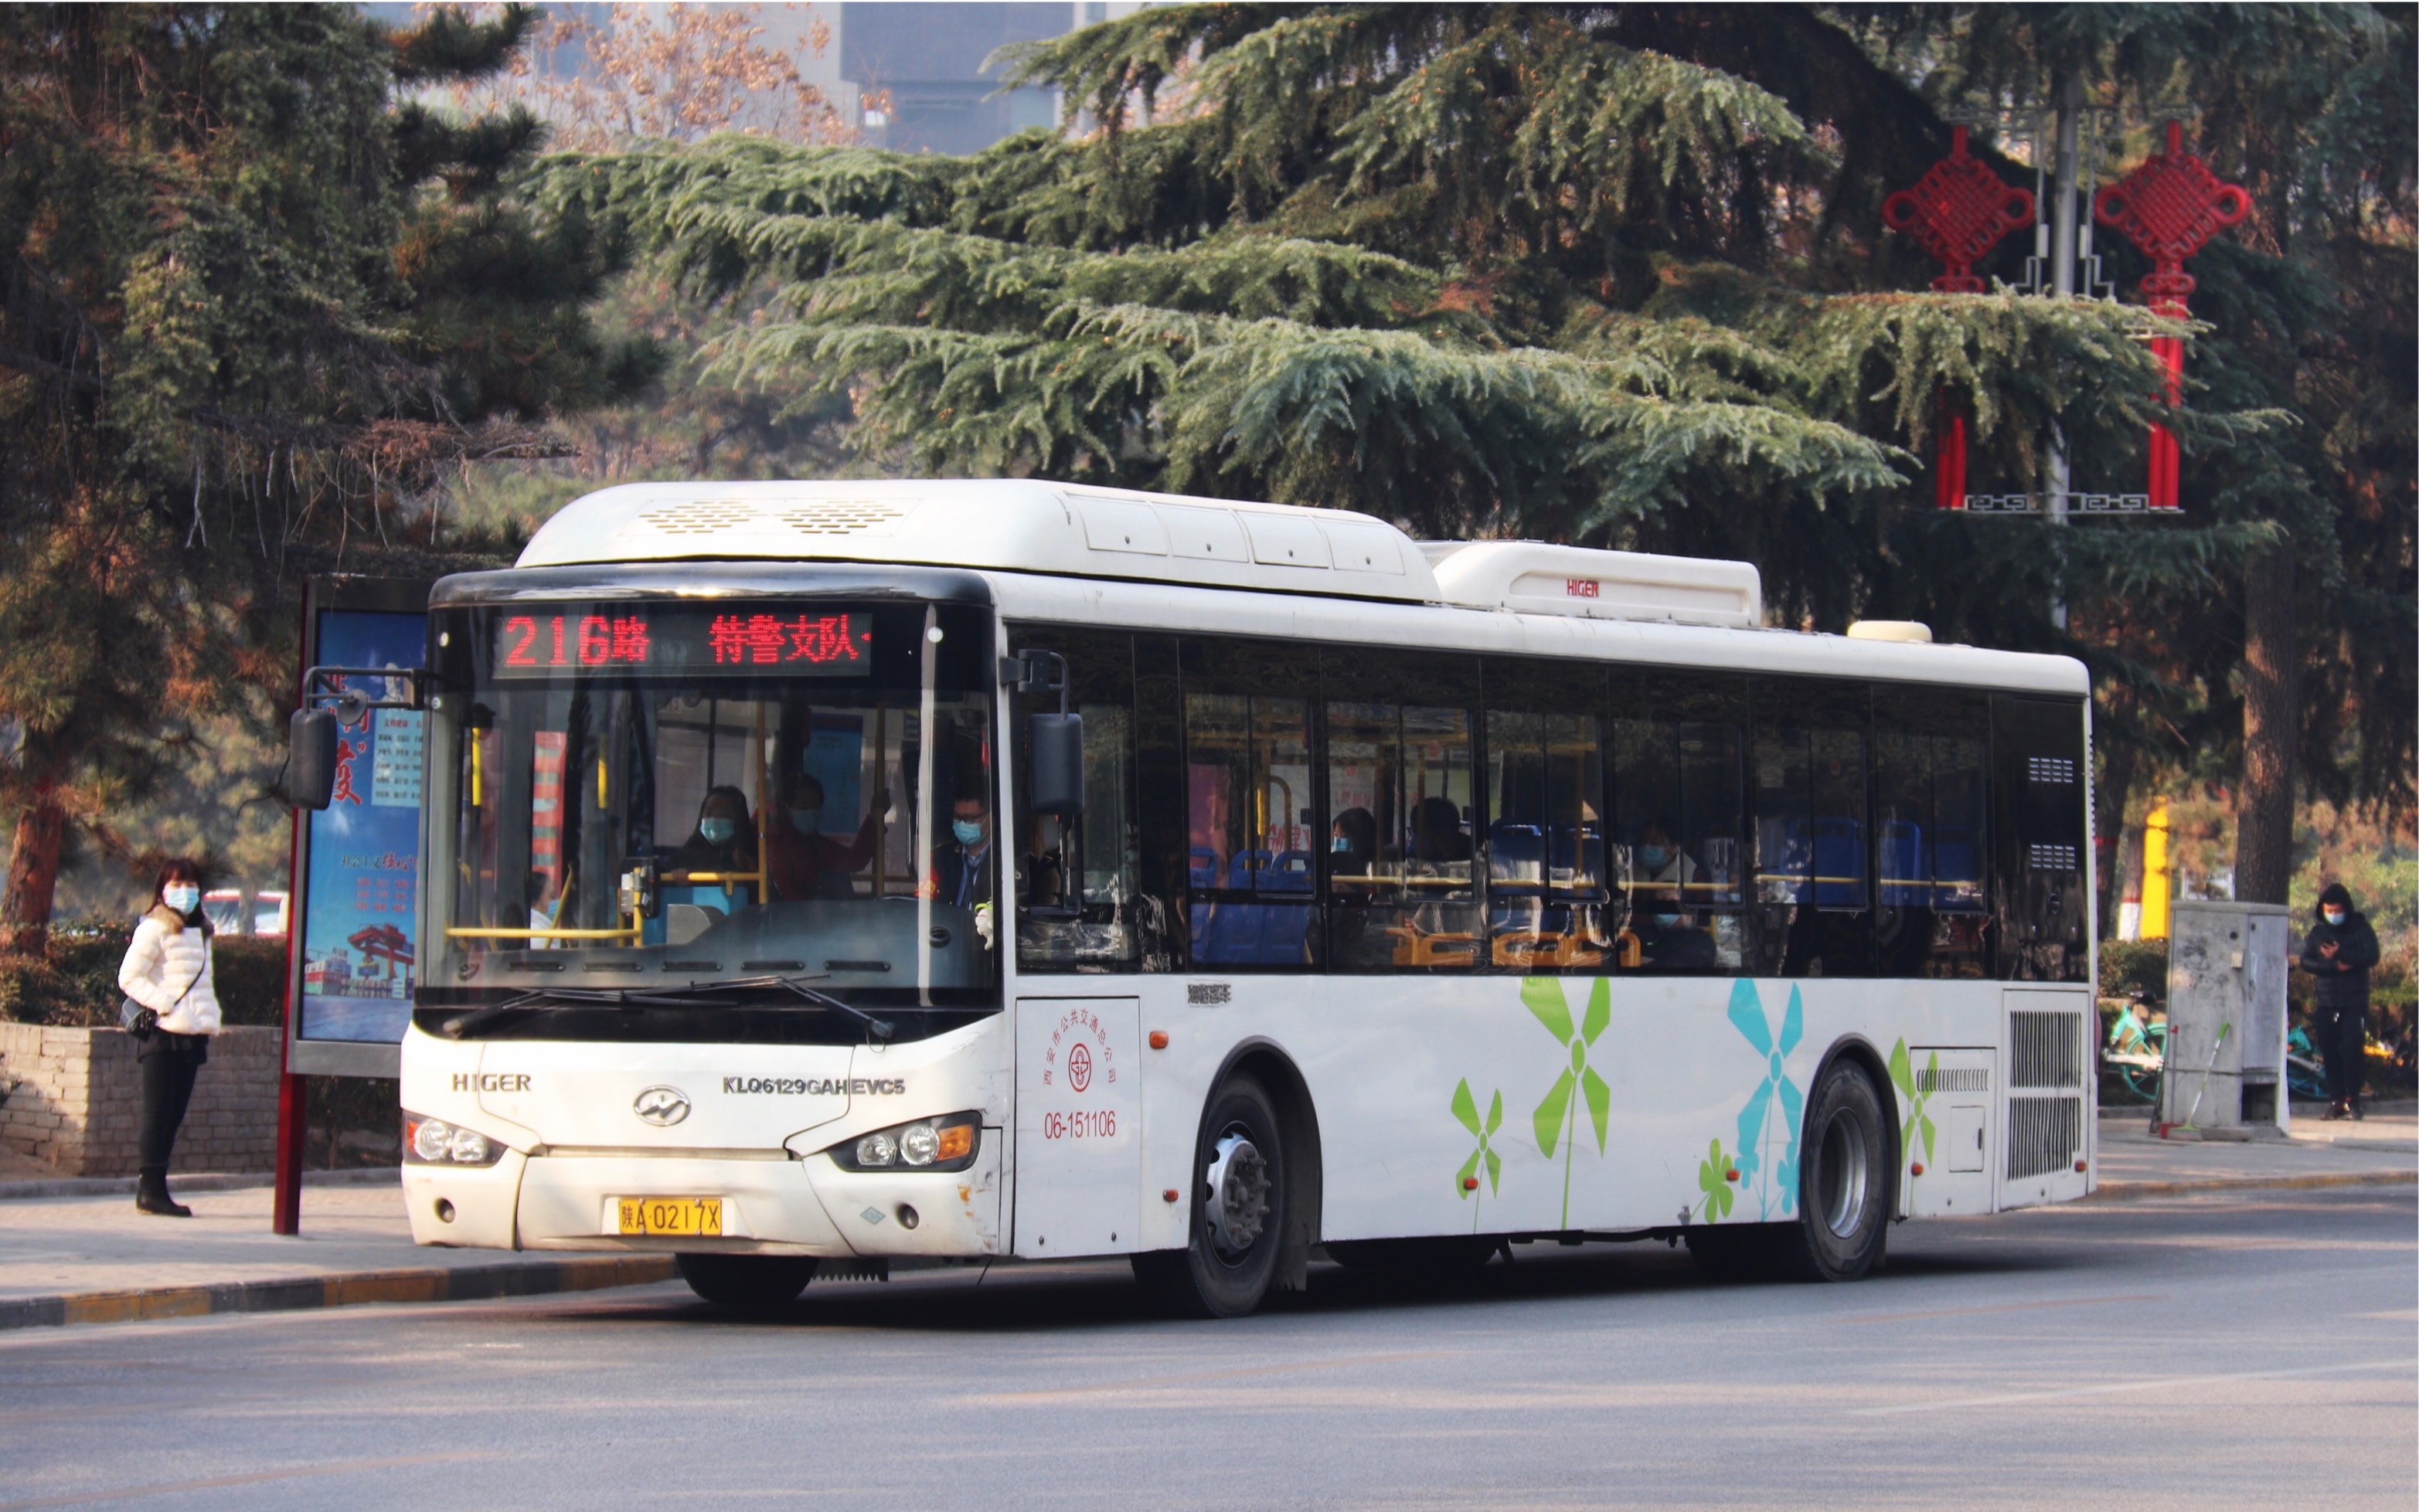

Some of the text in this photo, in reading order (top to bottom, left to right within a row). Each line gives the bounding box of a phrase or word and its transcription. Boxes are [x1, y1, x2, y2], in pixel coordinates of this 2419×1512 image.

[1567, 579, 1599, 598] HIGER
[505, 614, 859, 665] 216路 特警支队
[1043, 1007, 1116, 1086] 西安市公共交通总公司
[451, 1073, 531, 1092] HIGER
[723, 1076, 906, 1095] KLQ6129GAHEVC5
[1044, 1109, 1116, 1140] 06-151106
